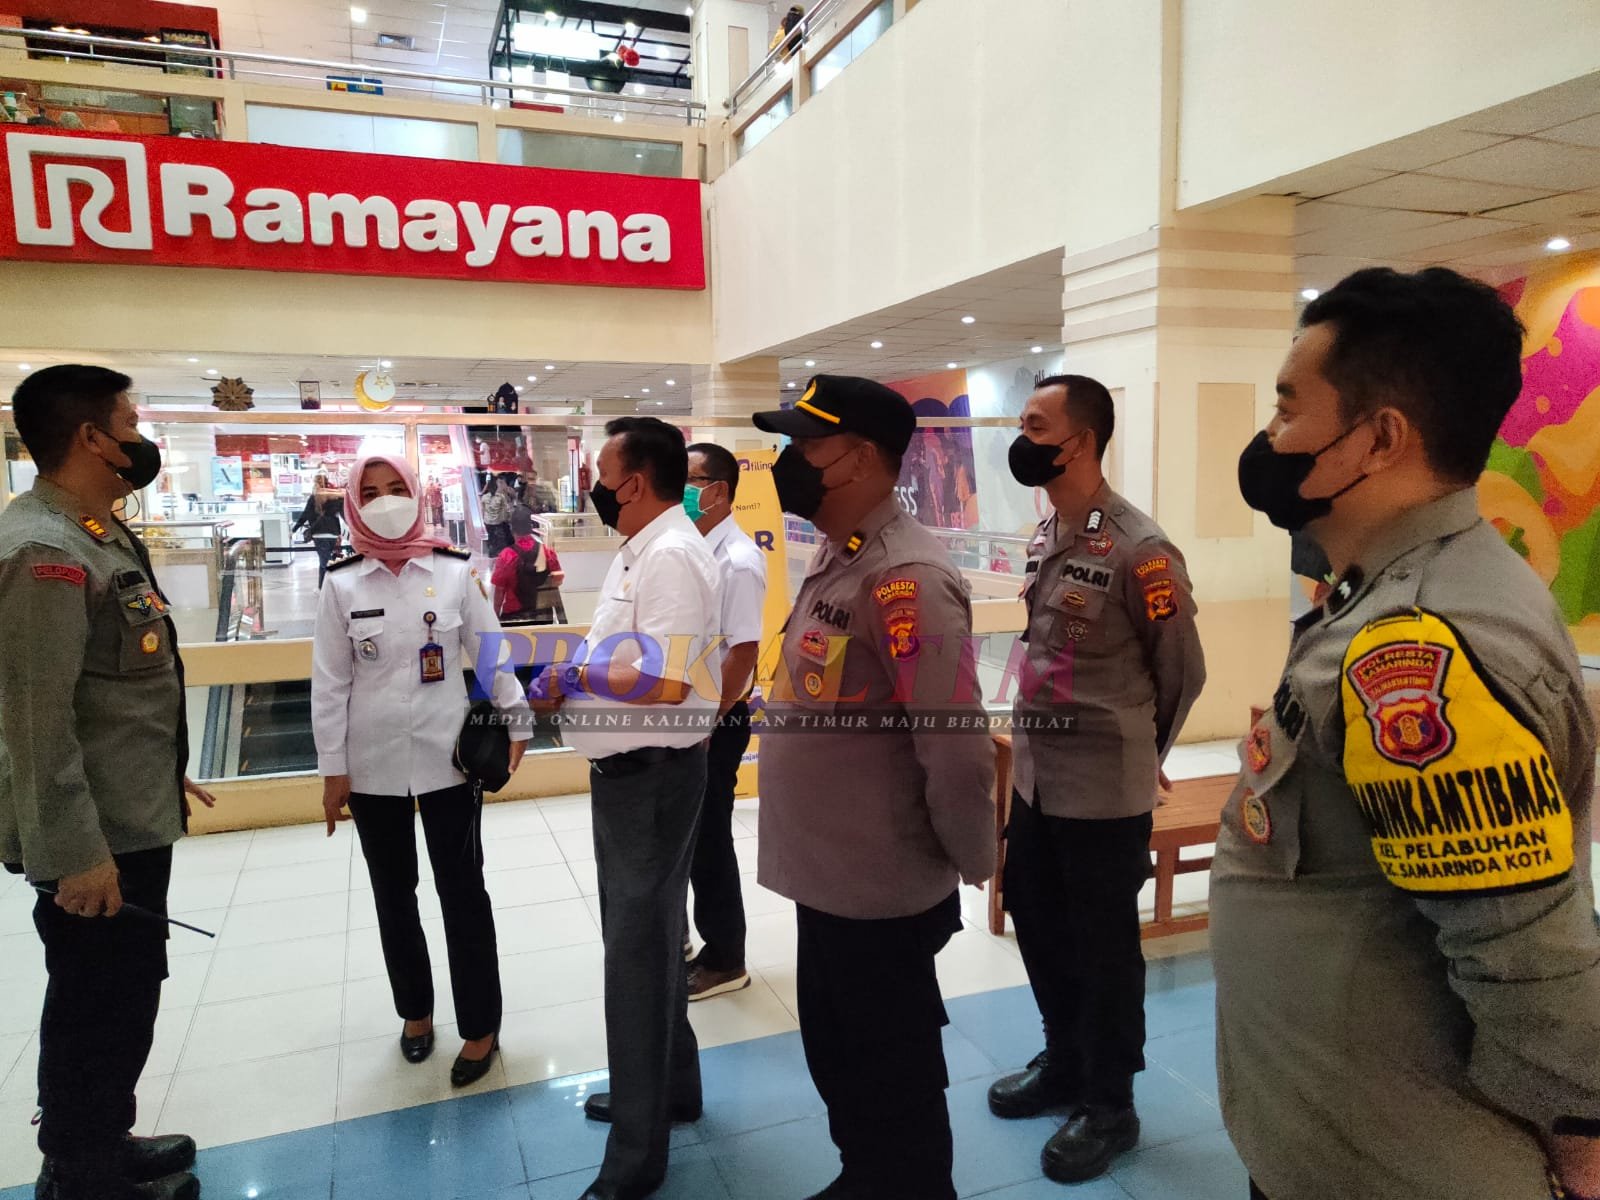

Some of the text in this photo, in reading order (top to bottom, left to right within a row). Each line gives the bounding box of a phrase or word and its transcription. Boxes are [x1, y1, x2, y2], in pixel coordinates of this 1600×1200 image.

[160, 162, 672, 268] Ramayana
[875, 581, 915, 598] POLRESTA
[1062, 563, 1110, 588] POLRI
[811, 600, 851, 631] POLRI
[1360, 649, 1435, 675] POLRESTA
[1362, 658, 1434, 681] SAMARINDA
[1405, 828, 1547, 860] PELABUHAN
[1400, 857, 1502, 879] SAMARINDA
[1504, 847, 1553, 871] KOTA
